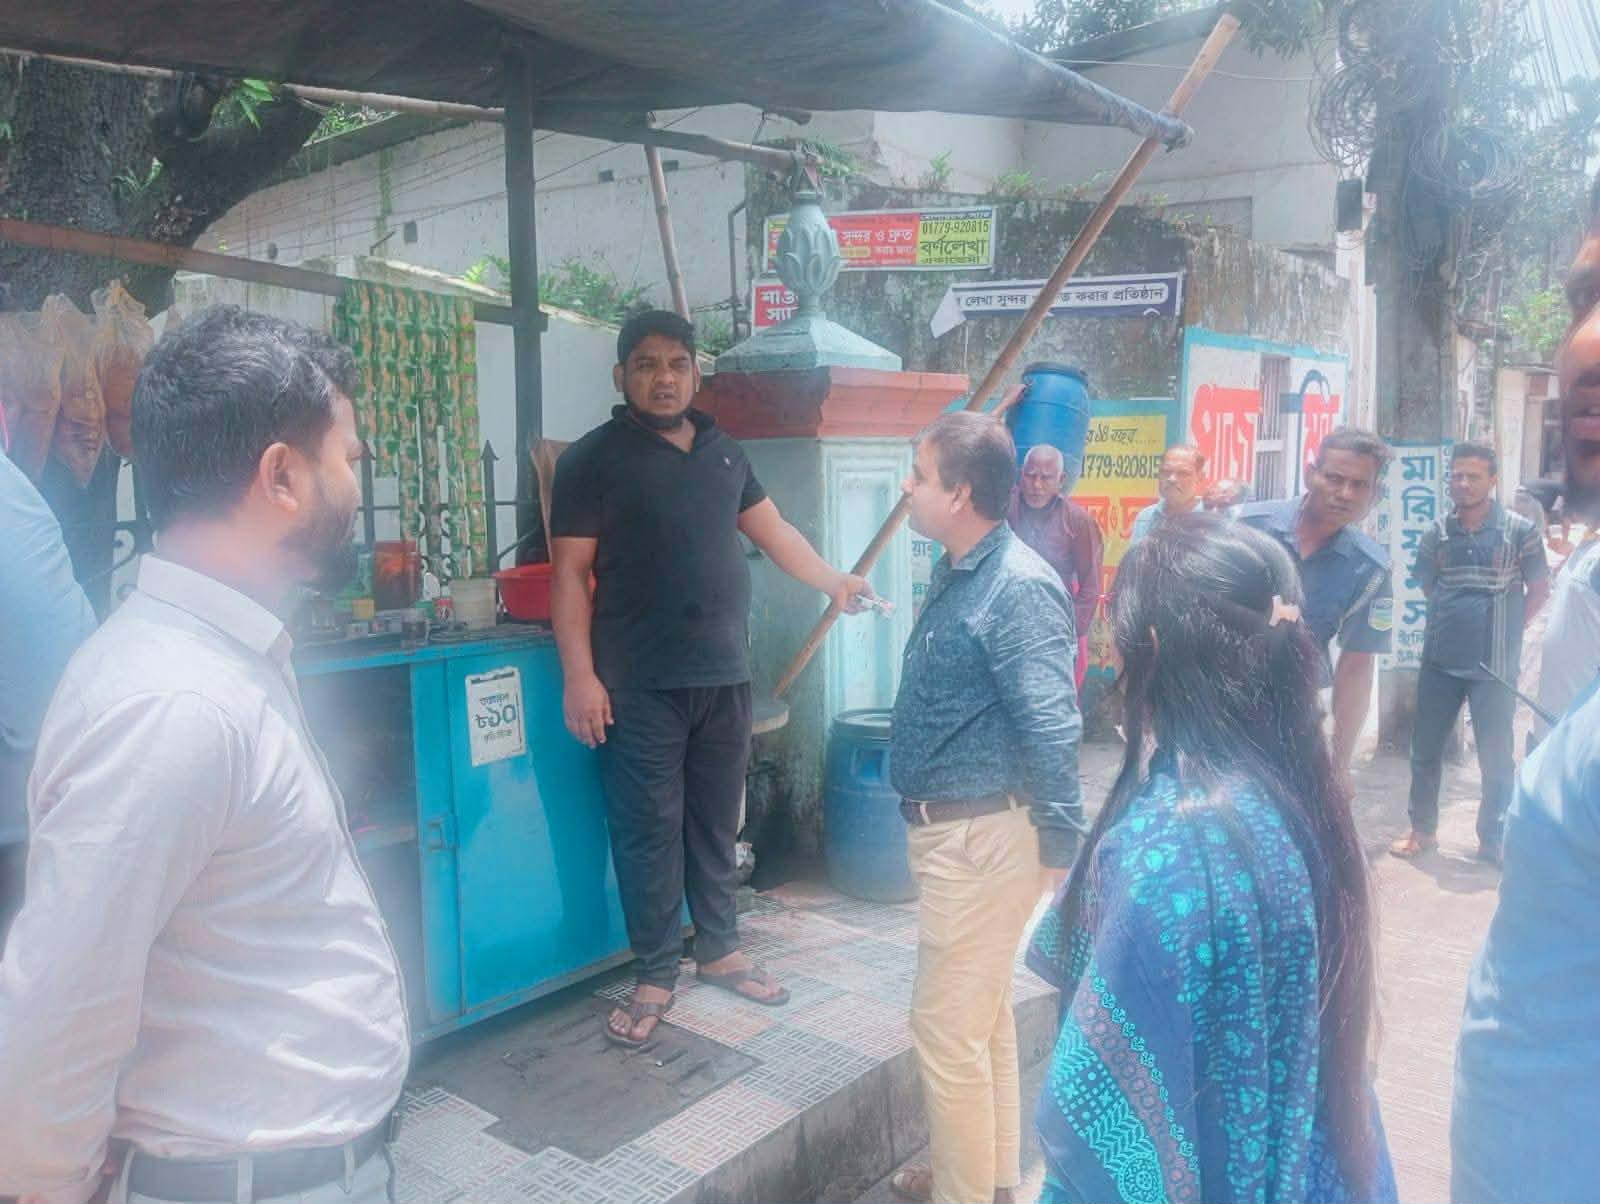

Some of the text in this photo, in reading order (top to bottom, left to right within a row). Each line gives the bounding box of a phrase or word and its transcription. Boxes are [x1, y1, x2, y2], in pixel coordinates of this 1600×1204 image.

[922, 219, 989, 235] 01779-920815
[920, 235, 988, 256] বর্ণলেখা
[966, 295, 992, 306] লেখা
[998, 295, 1026, 307] সুন্দর
[1076, 290, 1108, 302] করার
[1111, 285, 1163, 301] প্রতিষ্ঠান
[1080, 455, 1161, 480] 1779-920815
